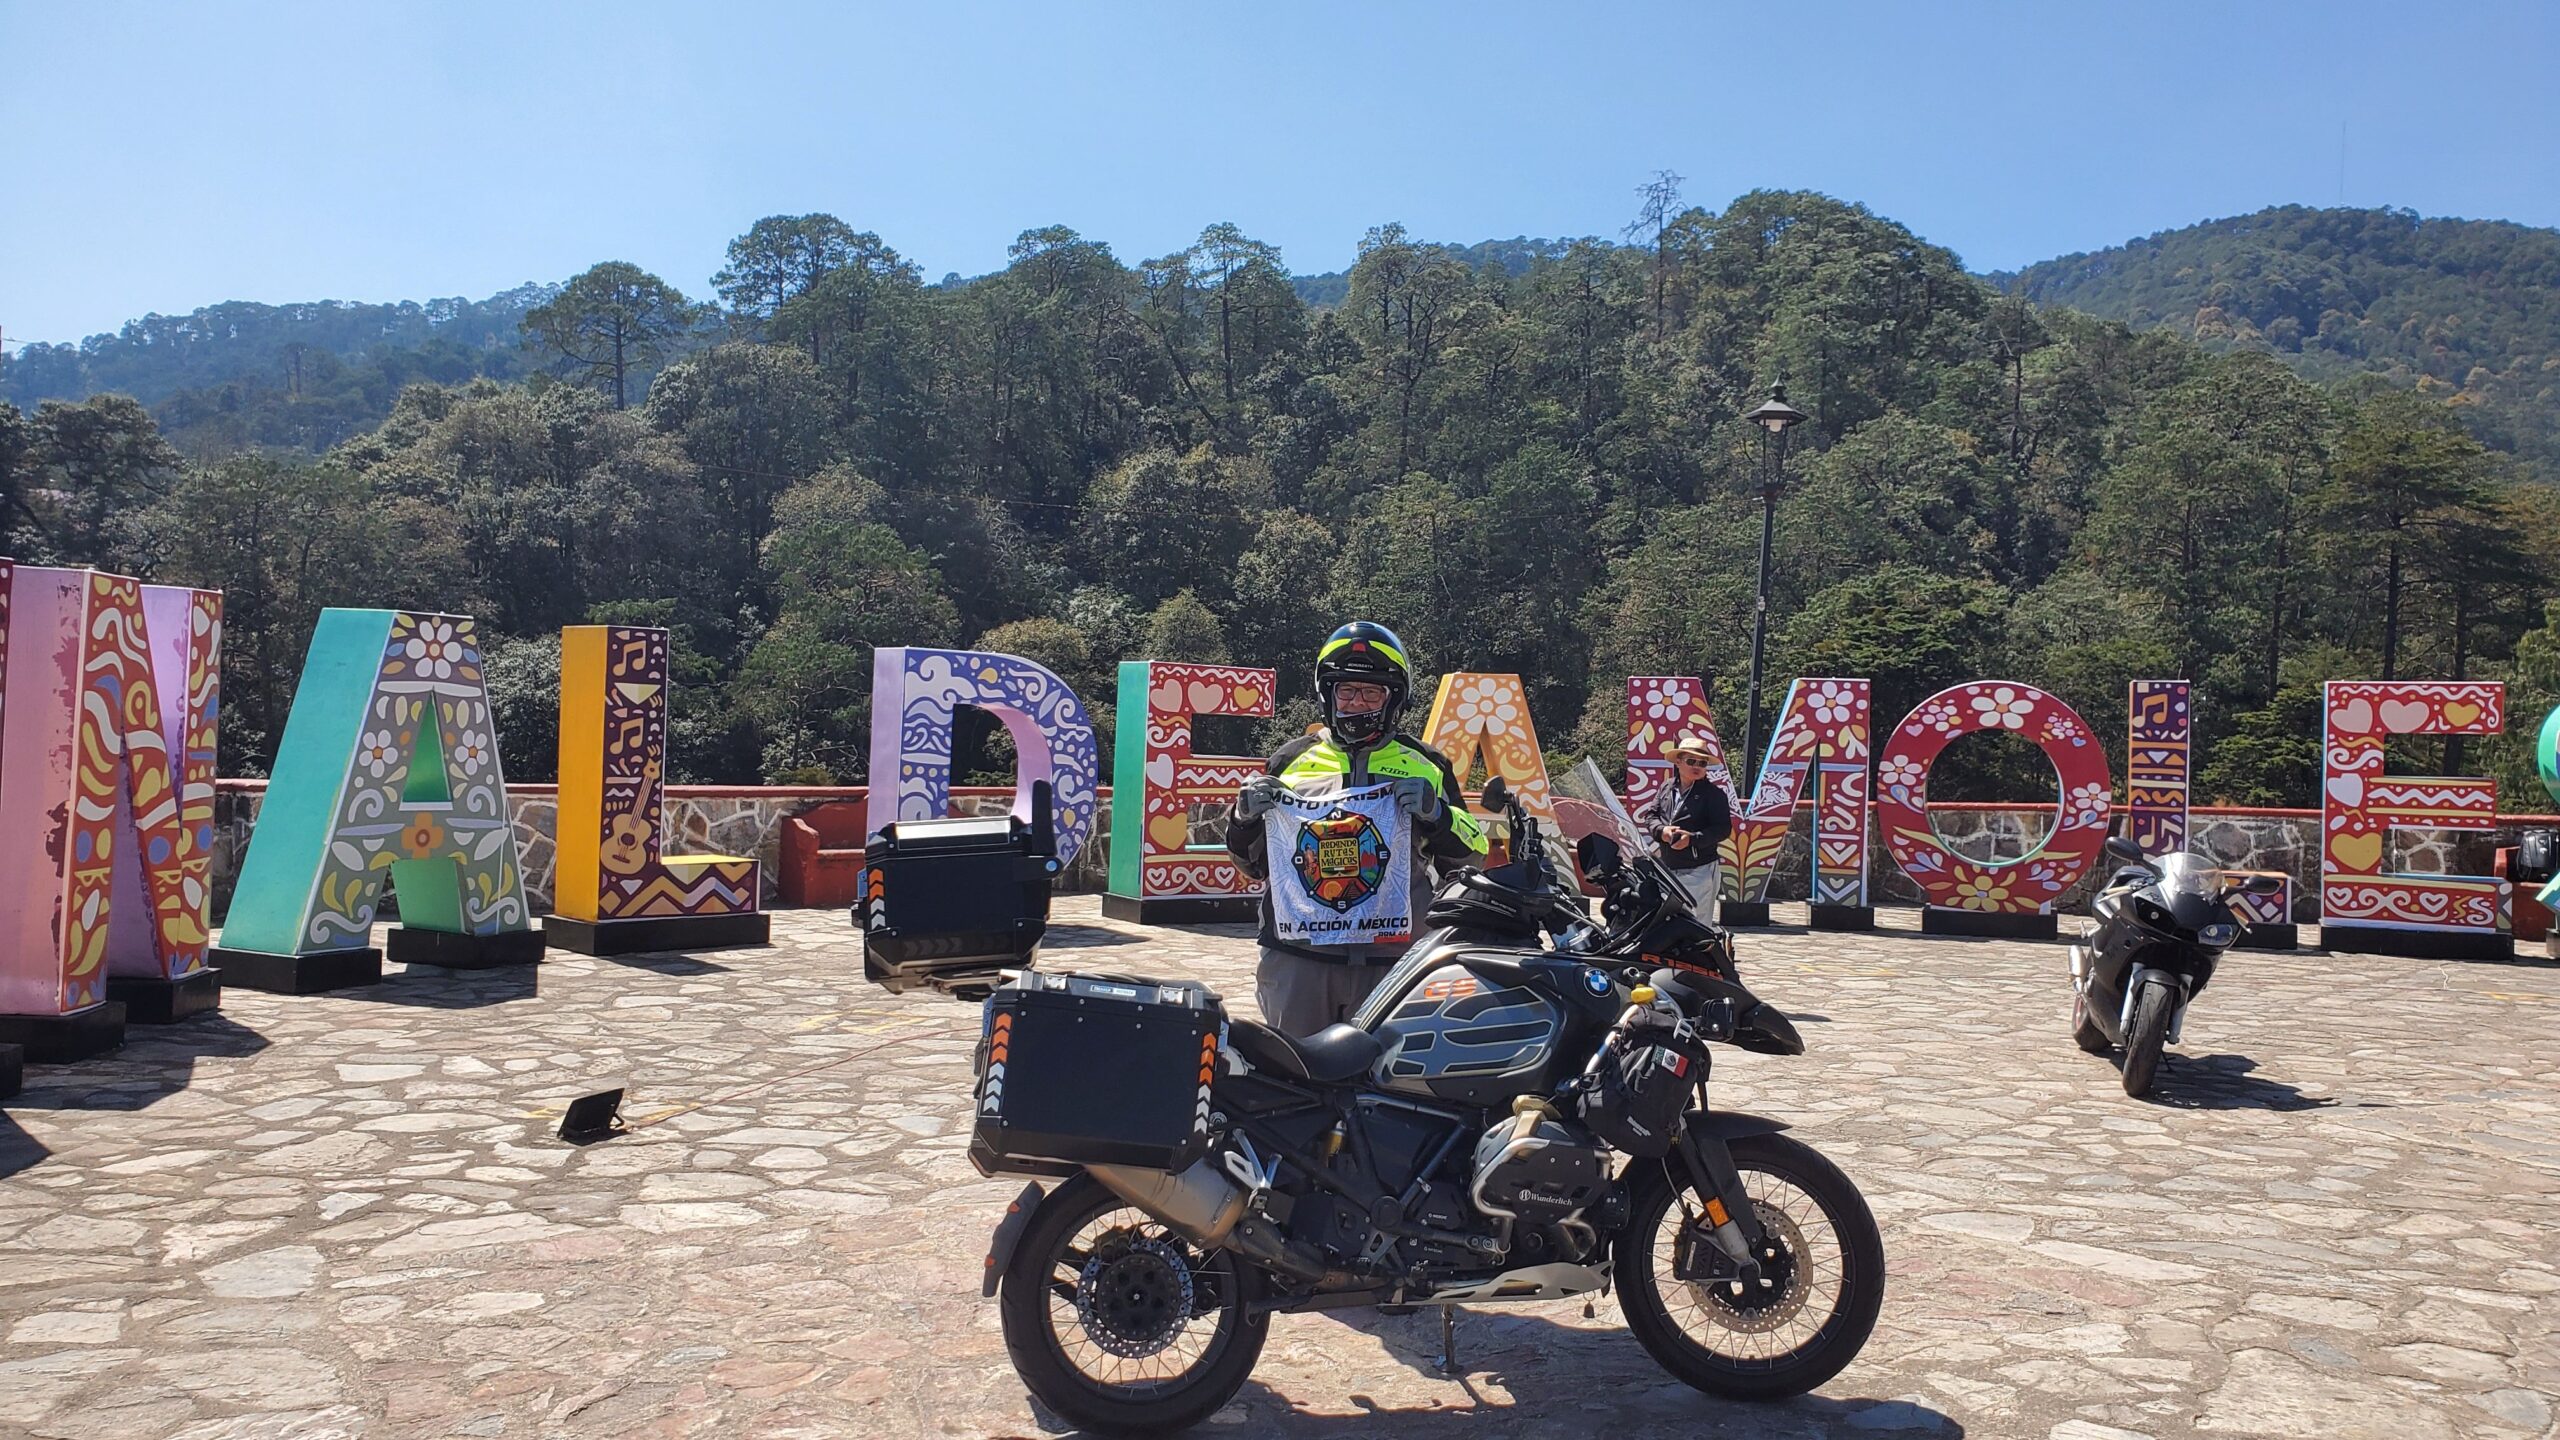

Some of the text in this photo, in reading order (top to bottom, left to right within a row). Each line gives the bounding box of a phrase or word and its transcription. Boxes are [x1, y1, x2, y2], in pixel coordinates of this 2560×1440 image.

[873, 646, 1277, 900] DE
[1421, 671, 2560, 935] AMOLE
[1331, 810, 1342, 820] N
[1294, 856, 1304, 865] O
[1379, 850, 1388, 859] E
[1337, 900, 1347, 909] S
[1279, 915, 1409, 933] EN ACCIÓN MÉXICO
[1424, 977, 1477, 999] GS
[1531, 1192, 1573, 1206] Wunderlich
